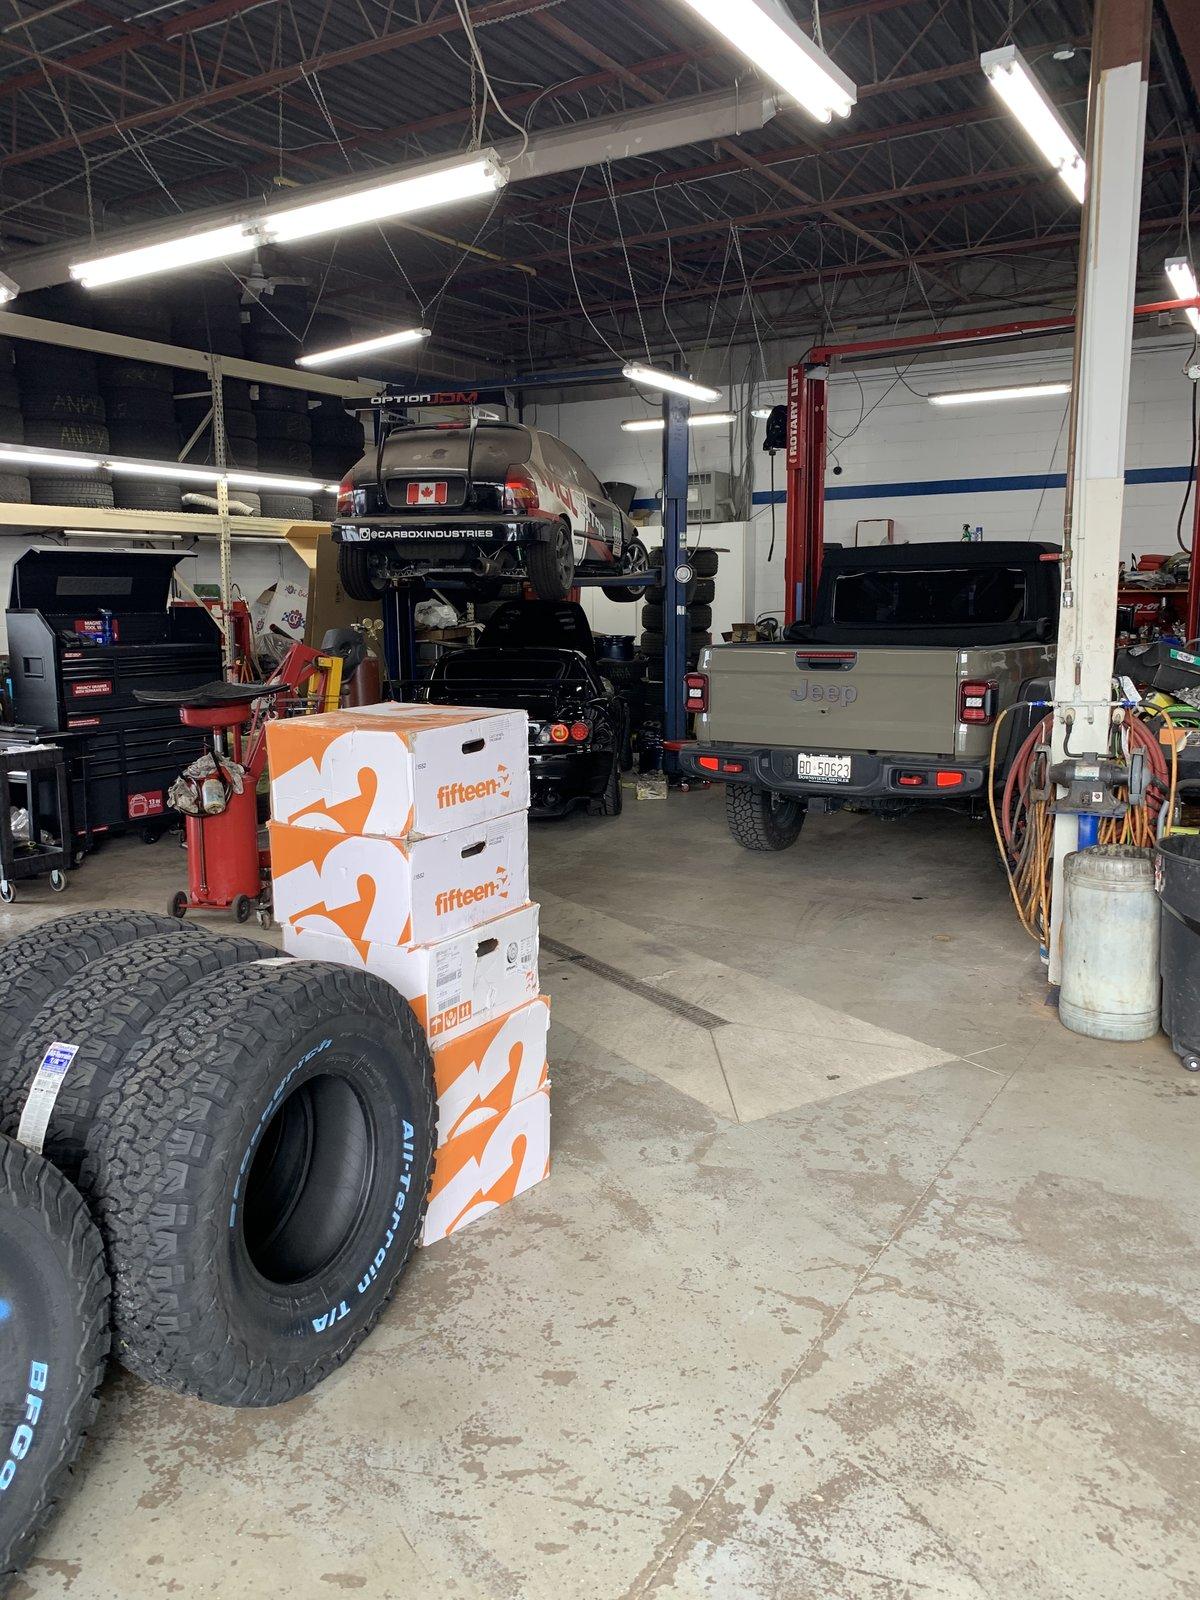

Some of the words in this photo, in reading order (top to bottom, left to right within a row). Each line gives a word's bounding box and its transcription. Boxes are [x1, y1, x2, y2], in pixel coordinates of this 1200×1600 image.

[791, 368, 799, 397] LIFT
[790, 401, 798, 456] ROTARY
[371, 530, 493, 538] @CARBOXINDUSTRIES
[791, 679, 857, 707] Jeep
[818, 762, 850, 777] 50623
[357, 1119, 415, 1294] All-Terrain
[311, 1300, 351, 1333] T/A
